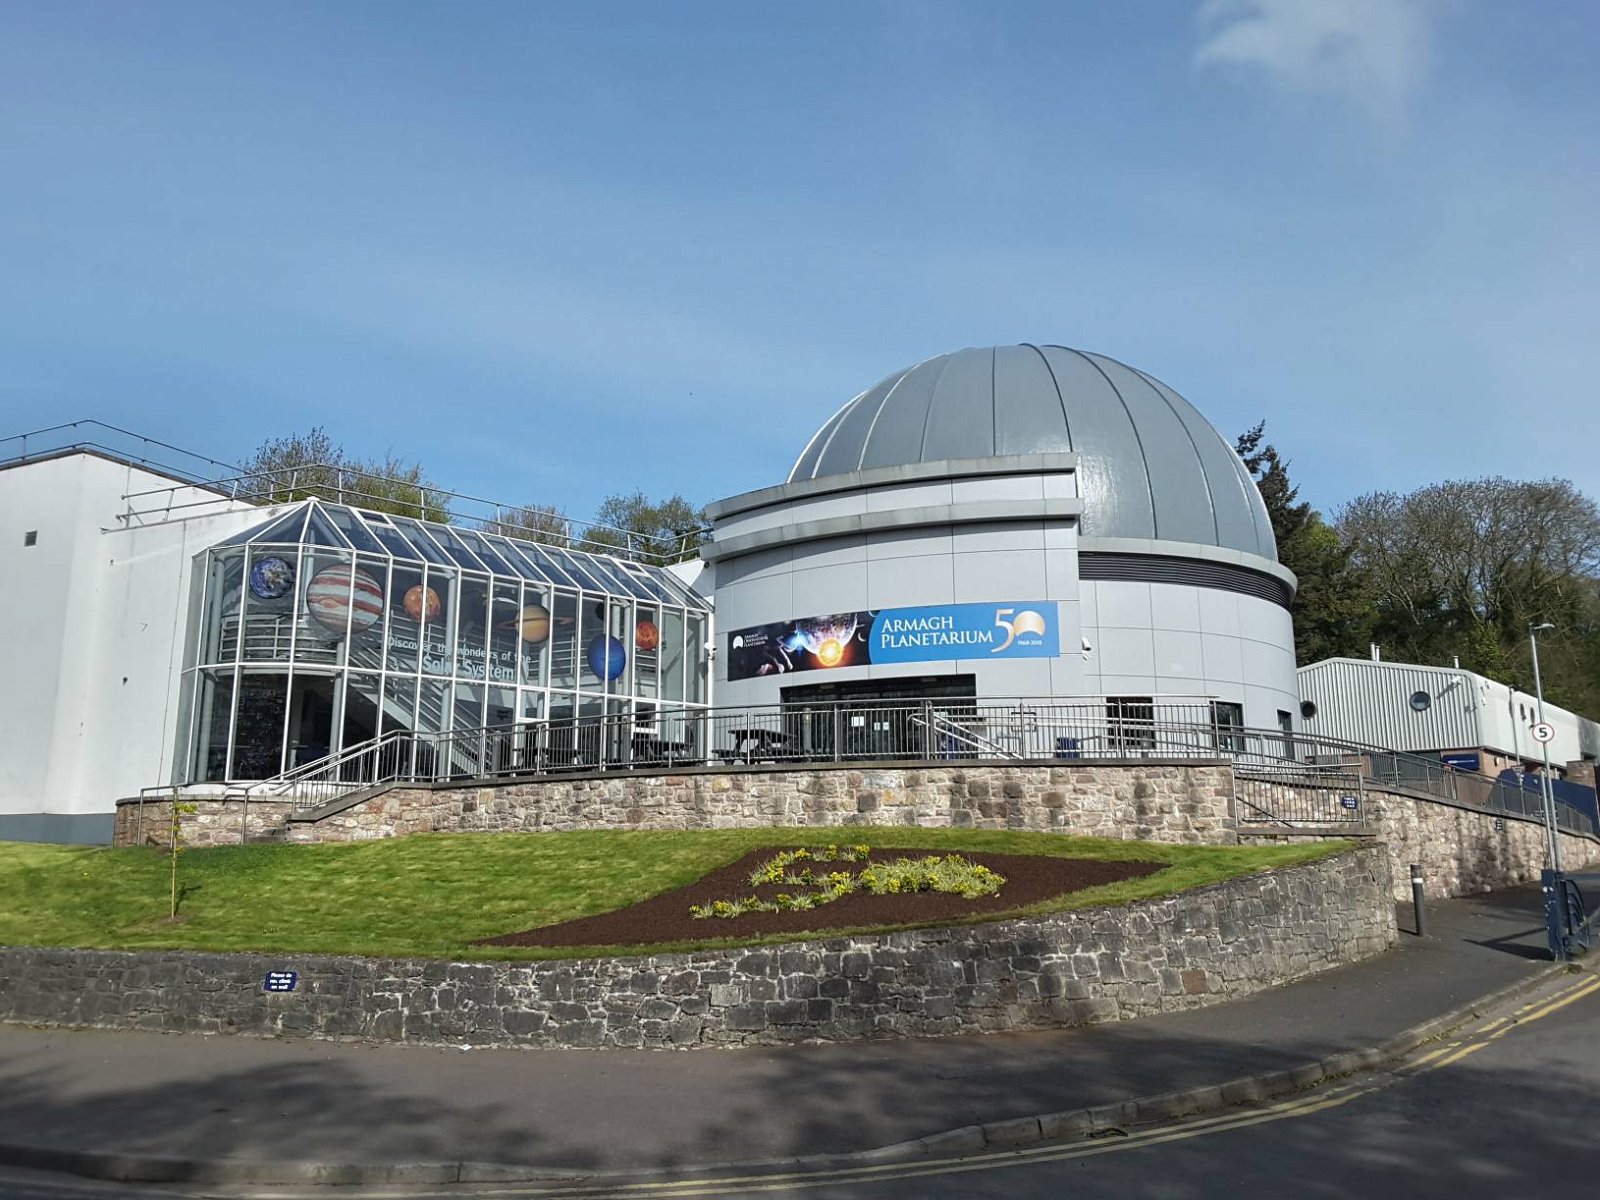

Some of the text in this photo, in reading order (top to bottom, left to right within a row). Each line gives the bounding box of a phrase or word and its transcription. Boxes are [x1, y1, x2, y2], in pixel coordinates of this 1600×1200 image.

[881, 616, 953, 634] ARMAGH
[881, 630, 994, 649] PLANETARIUM
[437, 642, 455, 655] th
[501, 651, 512, 661] of
[422, 655, 514, 680] Sol System
[1539, 727, 1548, 738] 5
